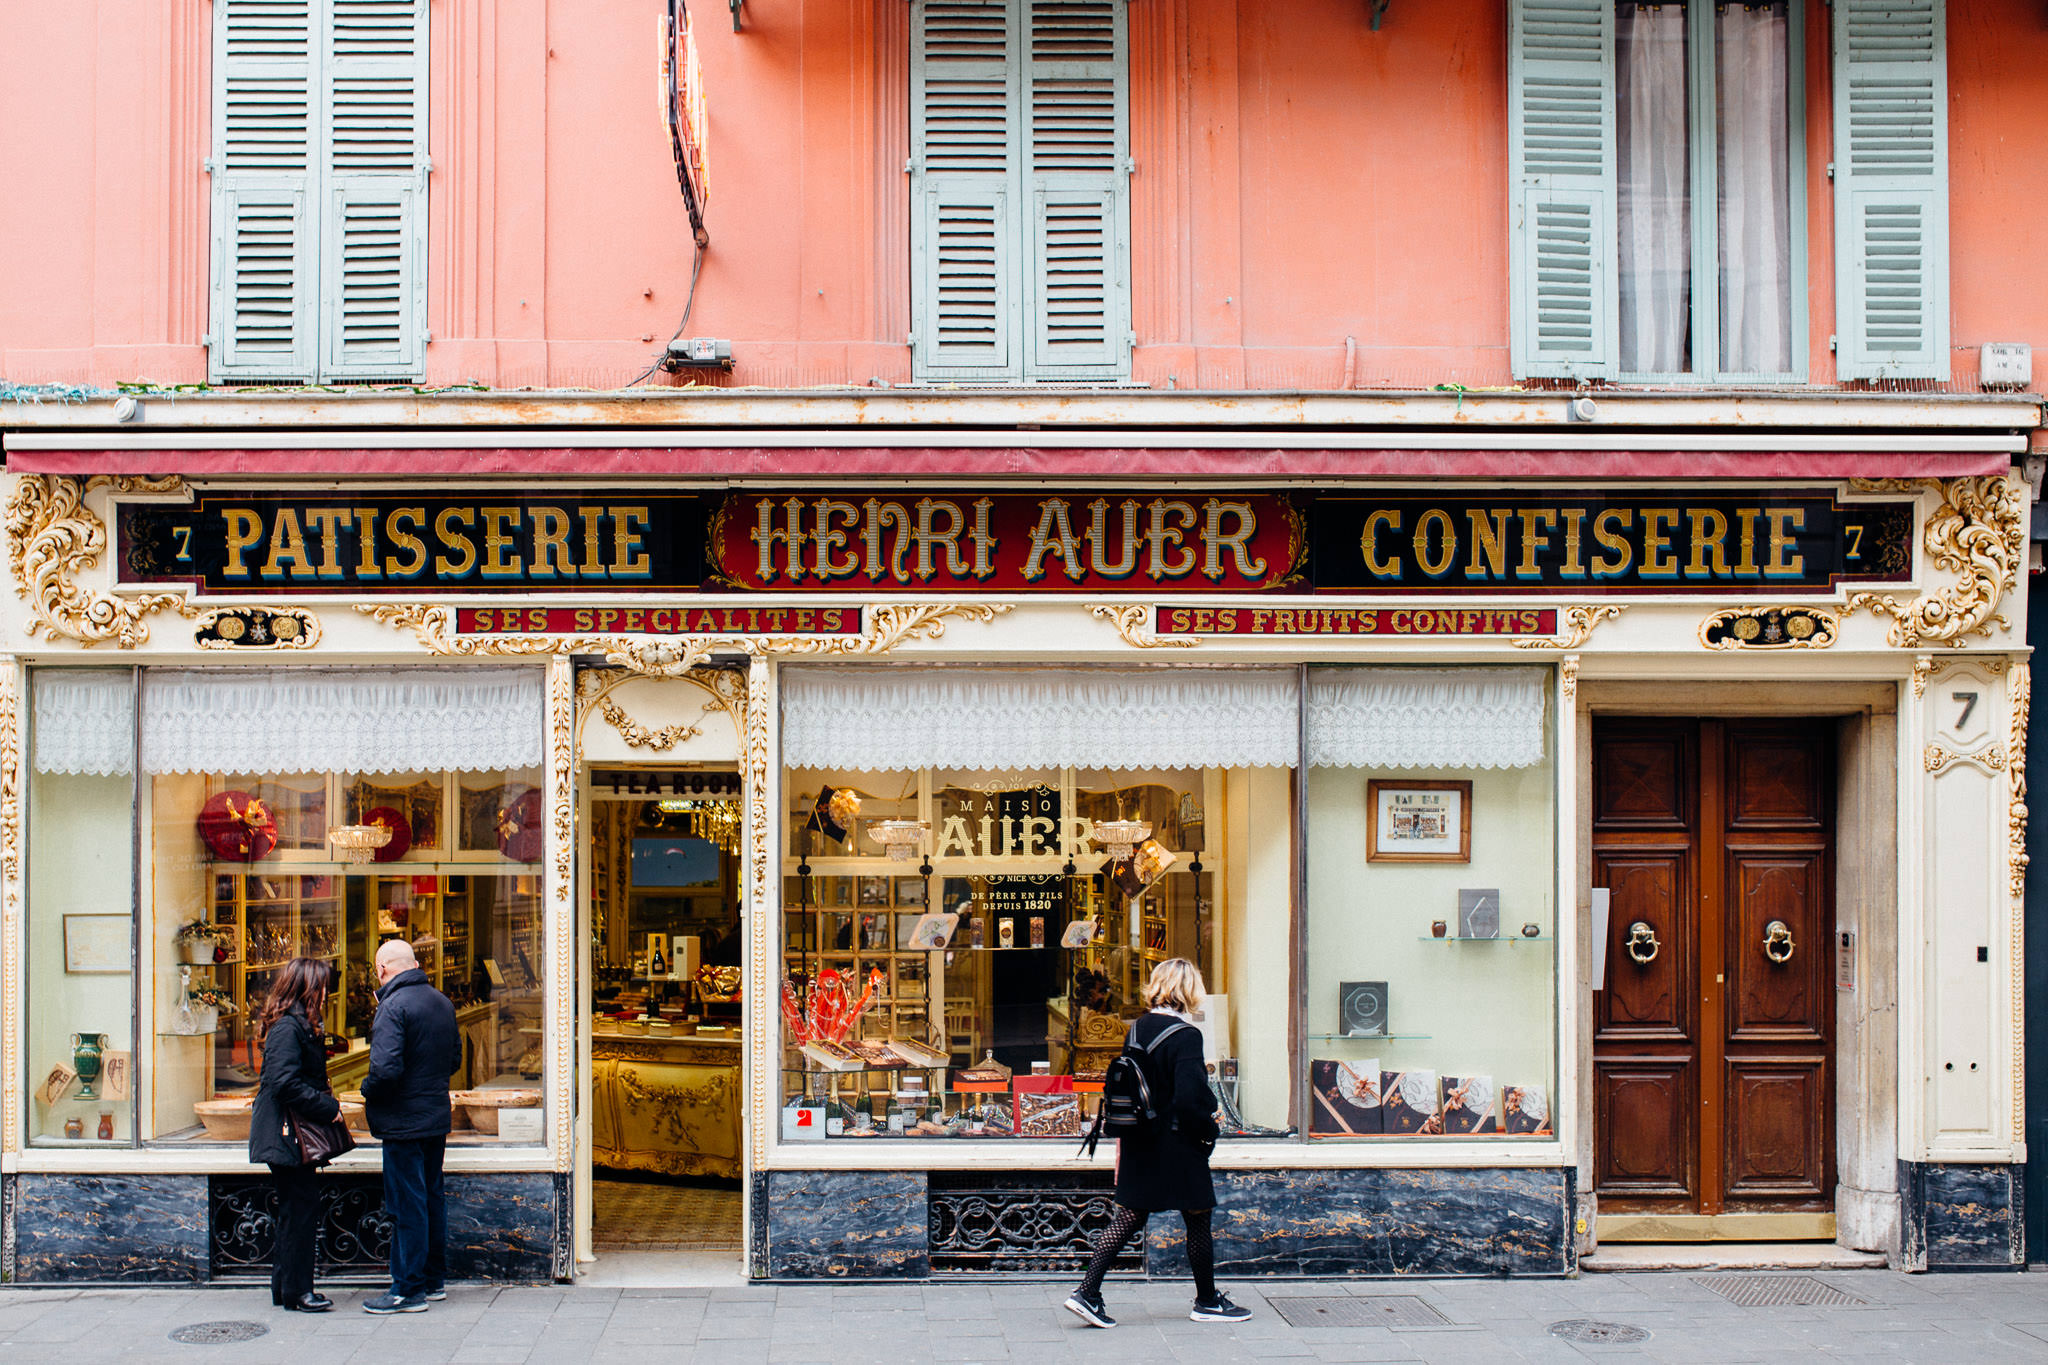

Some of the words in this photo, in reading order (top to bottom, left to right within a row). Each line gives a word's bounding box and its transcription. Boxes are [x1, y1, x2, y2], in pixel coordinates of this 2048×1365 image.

[172, 526, 192, 562] 7
[222, 507, 652, 580] PATISSERIE
[751, 497, 998, 586] HENRI
[1019, 497, 1268, 586] AUER
[1360, 508, 1806, 580] CONFISERIE
[1845, 525, 1863, 560] 7
[474, 608, 548, 632] SES
[574, 608, 843, 632] SPECIALITES
[1171, 608, 1238, 632] SES
[1251, 608, 1378, 633] FRUITS
[1390, 608, 1540, 634] CONFITS
[1952, 692, 1978, 728] 7
[610, 774, 661, 794] TEA
[673, 774, 742, 795] ROOM
[933, 814, 1103, 863] AUER
[971, 892, 985, 900] DE
[1021, 892, 1035, 900] EN
[1039, 892, 1063, 900] FILS
[1024, 900, 1051, 910] 1820
